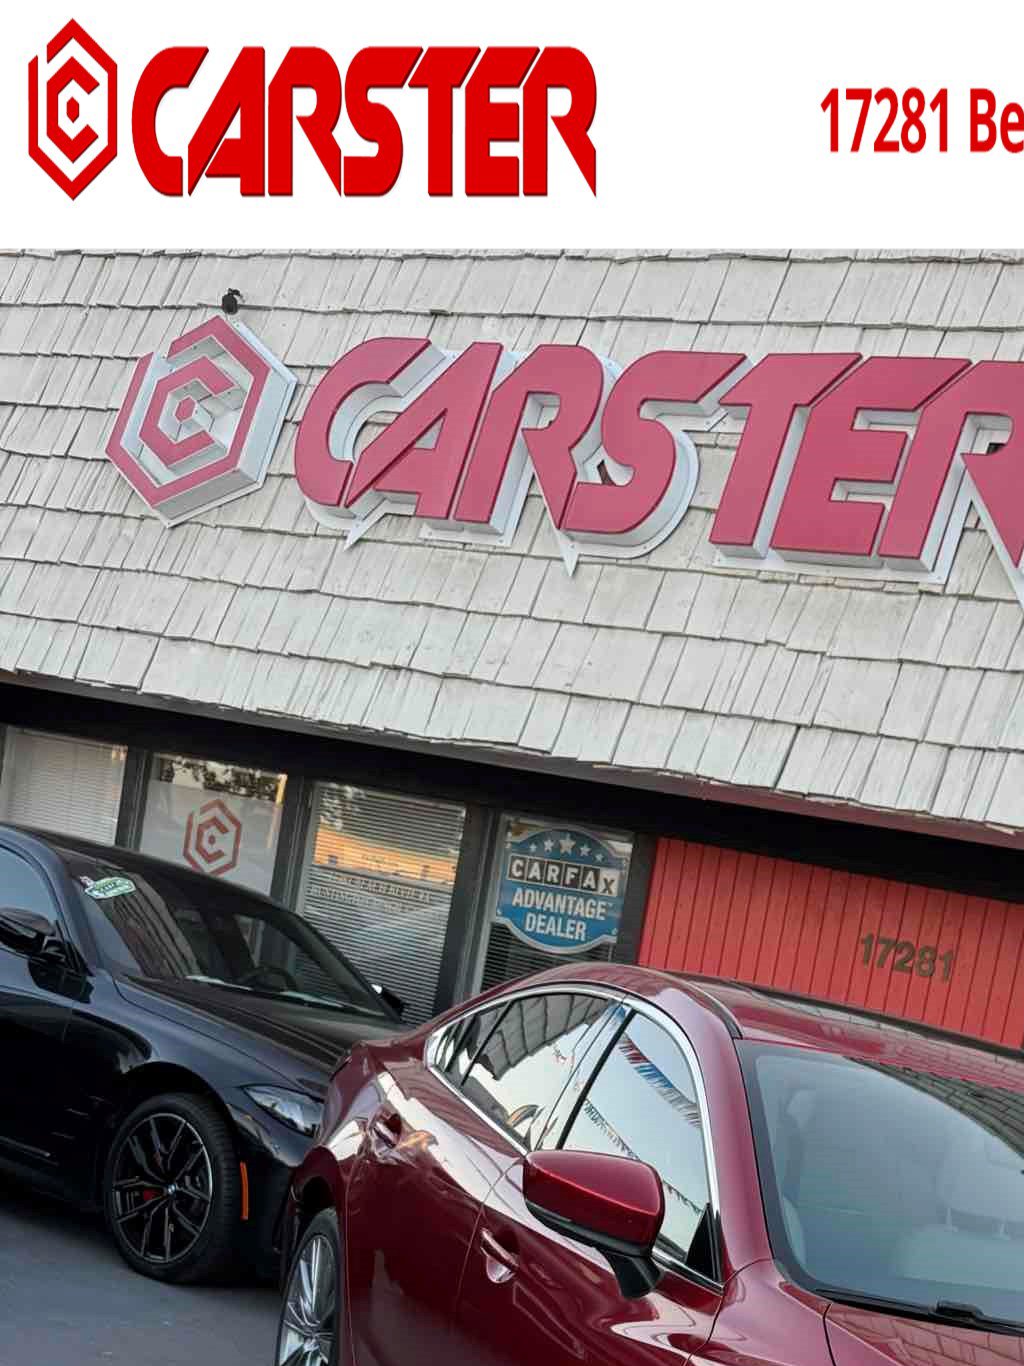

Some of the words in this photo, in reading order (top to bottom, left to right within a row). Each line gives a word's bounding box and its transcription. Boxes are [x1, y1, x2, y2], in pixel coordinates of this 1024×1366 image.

[510, 858, 617, 896] CARFAX
[512, 887, 607, 920] ADVANTAGE
[525, 912, 587, 941] DEALER
[861, 932, 954, 984] 17281
